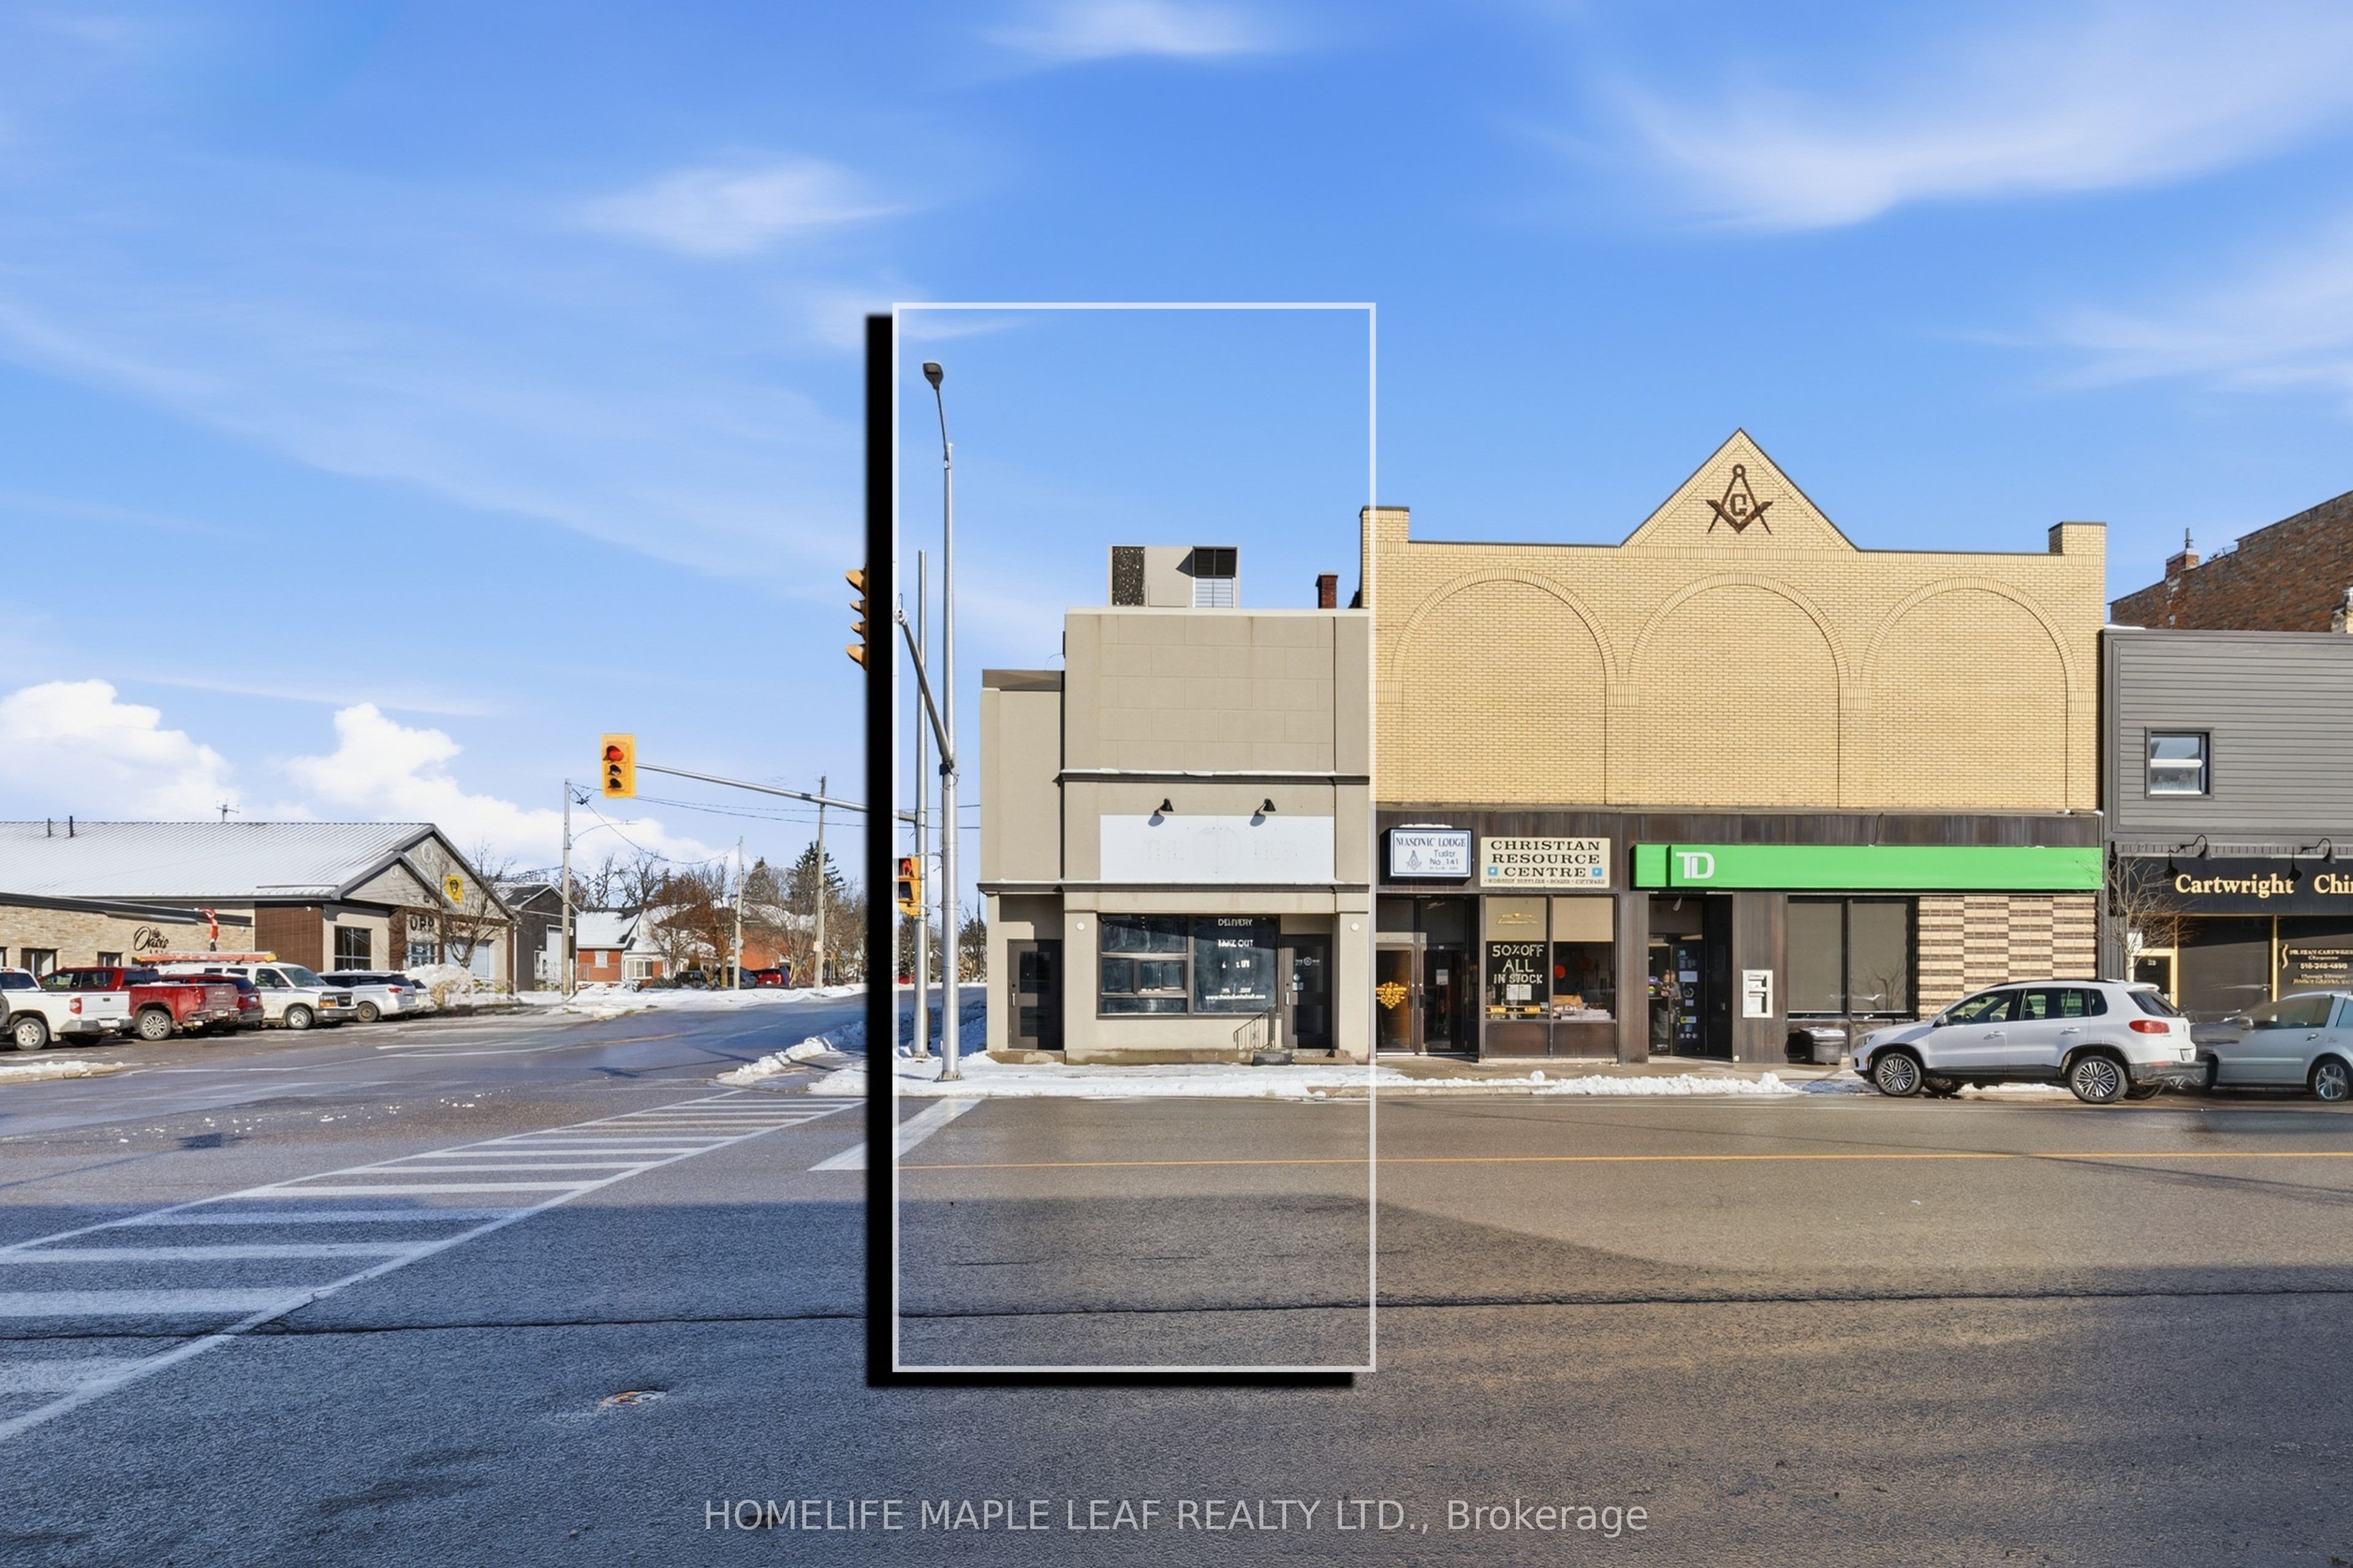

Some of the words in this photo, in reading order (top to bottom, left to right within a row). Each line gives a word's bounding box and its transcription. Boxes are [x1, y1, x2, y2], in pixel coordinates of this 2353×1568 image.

[1396, 837, 1436, 846] MASONIC
[1439, 837, 1466, 847] LODGE
[1490, 840, 1600, 850] CHRISTIAN
[1491, 854, 1600, 865] RESOURCE
[1676, 852, 1715, 879] TD
[1504, 867, 1586, 877] CENTRE
[2175, 873, 2295, 899] Cartwright
[1237, 939, 1254, 947] OUT
[1502, 958, 1534, 973] ALL
[1493, 973, 1506, 984] IN
[1509, 973, 1543, 984] STOCK
